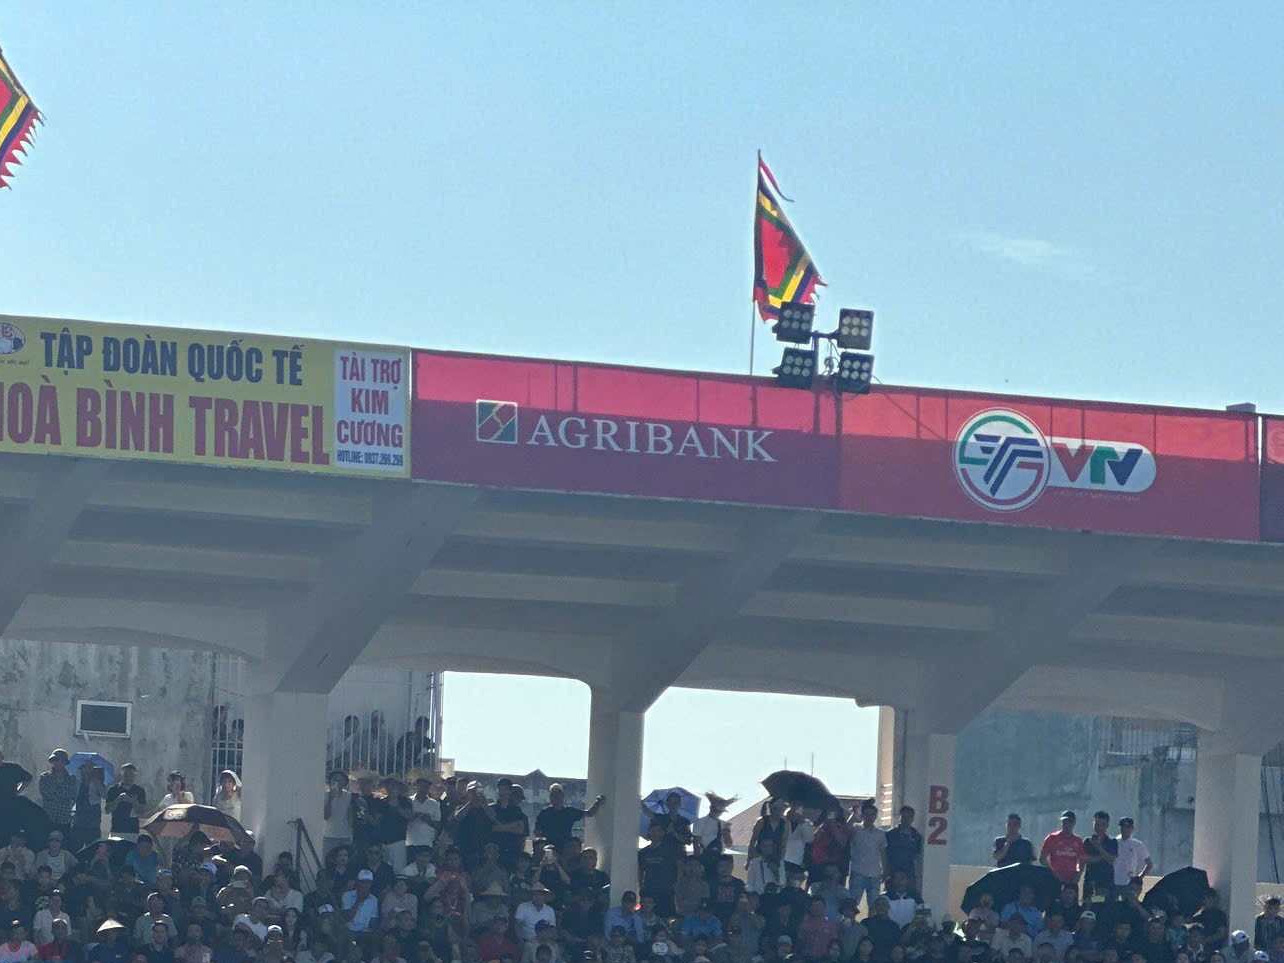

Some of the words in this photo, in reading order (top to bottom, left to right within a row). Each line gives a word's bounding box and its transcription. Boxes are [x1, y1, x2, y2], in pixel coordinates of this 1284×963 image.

[39, 327, 93, 376] TẬP
[101, 333, 178, 377] ĐOÀN
[187, 339, 264, 383] QUỐC
[272, 344, 306, 386] TẾ
[339, 352, 366, 382] TÀI
[370, 356, 402, 390] TRỢ
[75, 379, 175, 454] BÌNH
[188, 395, 330, 466] TRAVEL
[350, 388, 389, 415] KIM
[336, 419, 404, 449] CƯƠNG
[525, 414, 779, 464] AGRIBANK
[1051, 442, 1144, 487] VTV
